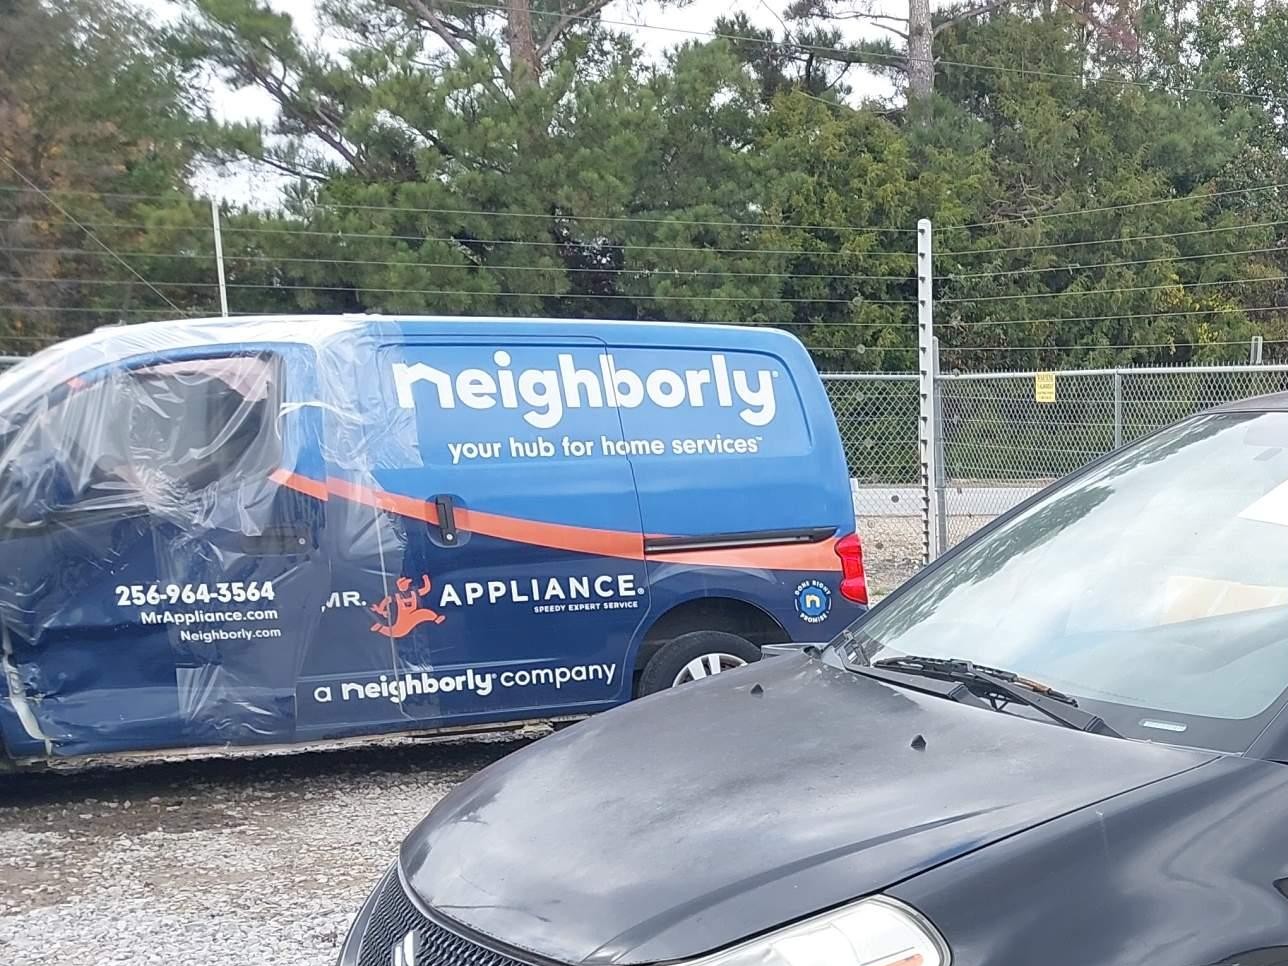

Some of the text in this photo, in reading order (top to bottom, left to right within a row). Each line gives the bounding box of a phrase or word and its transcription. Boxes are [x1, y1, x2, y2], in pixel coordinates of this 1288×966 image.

[391, 350, 777, 429] neighborly
[447, 434, 758, 465] your hub for home services
[115, 580, 275, 606] 256-964-3564
[140, 608, 278, 626] MrAppliance.com
[534, 600, 639, 614] SPEEDY EXPERT SERVICE
[180, 627, 282, 643] Neighborly.com
[314, 663, 616, 704] a neighborly company
